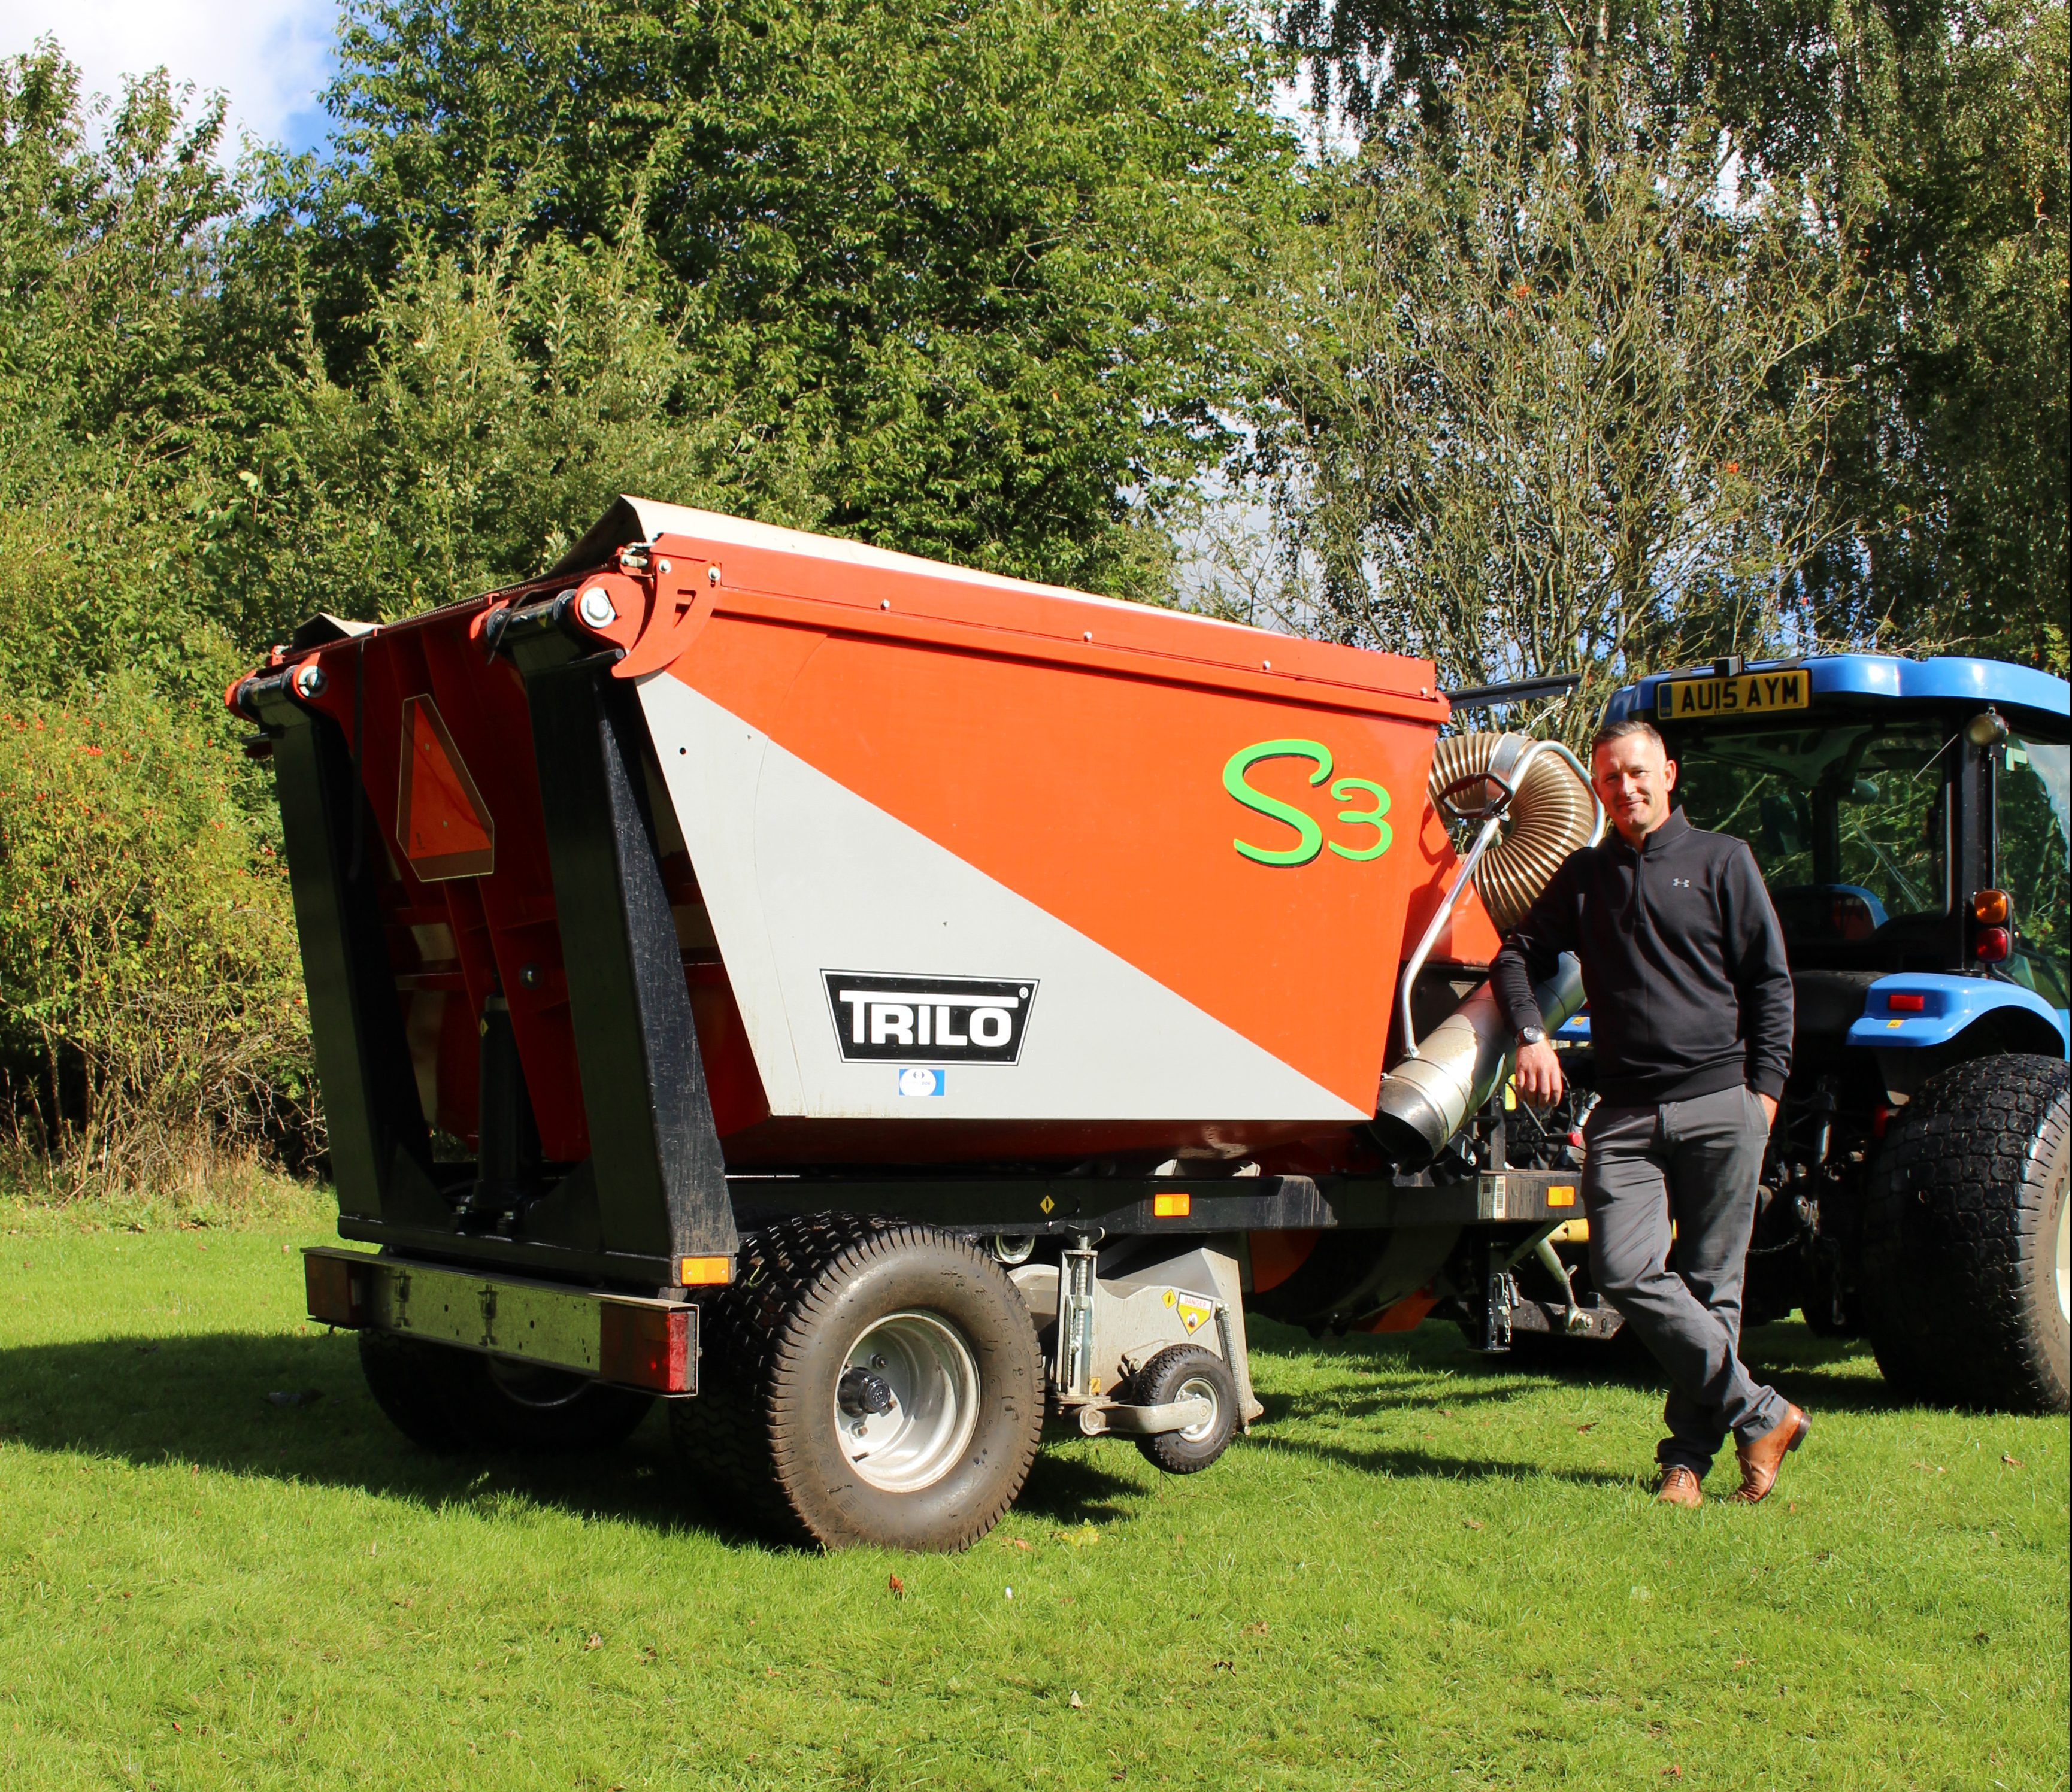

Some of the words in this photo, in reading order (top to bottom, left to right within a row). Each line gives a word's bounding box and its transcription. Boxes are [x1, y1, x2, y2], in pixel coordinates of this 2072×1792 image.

[1681, 681, 1737, 712] AU15
[1747, 676, 1799, 707] AYM
[1222, 739, 1393, 868] S3
[1185, 1297, 1207, 1308] DANGER
